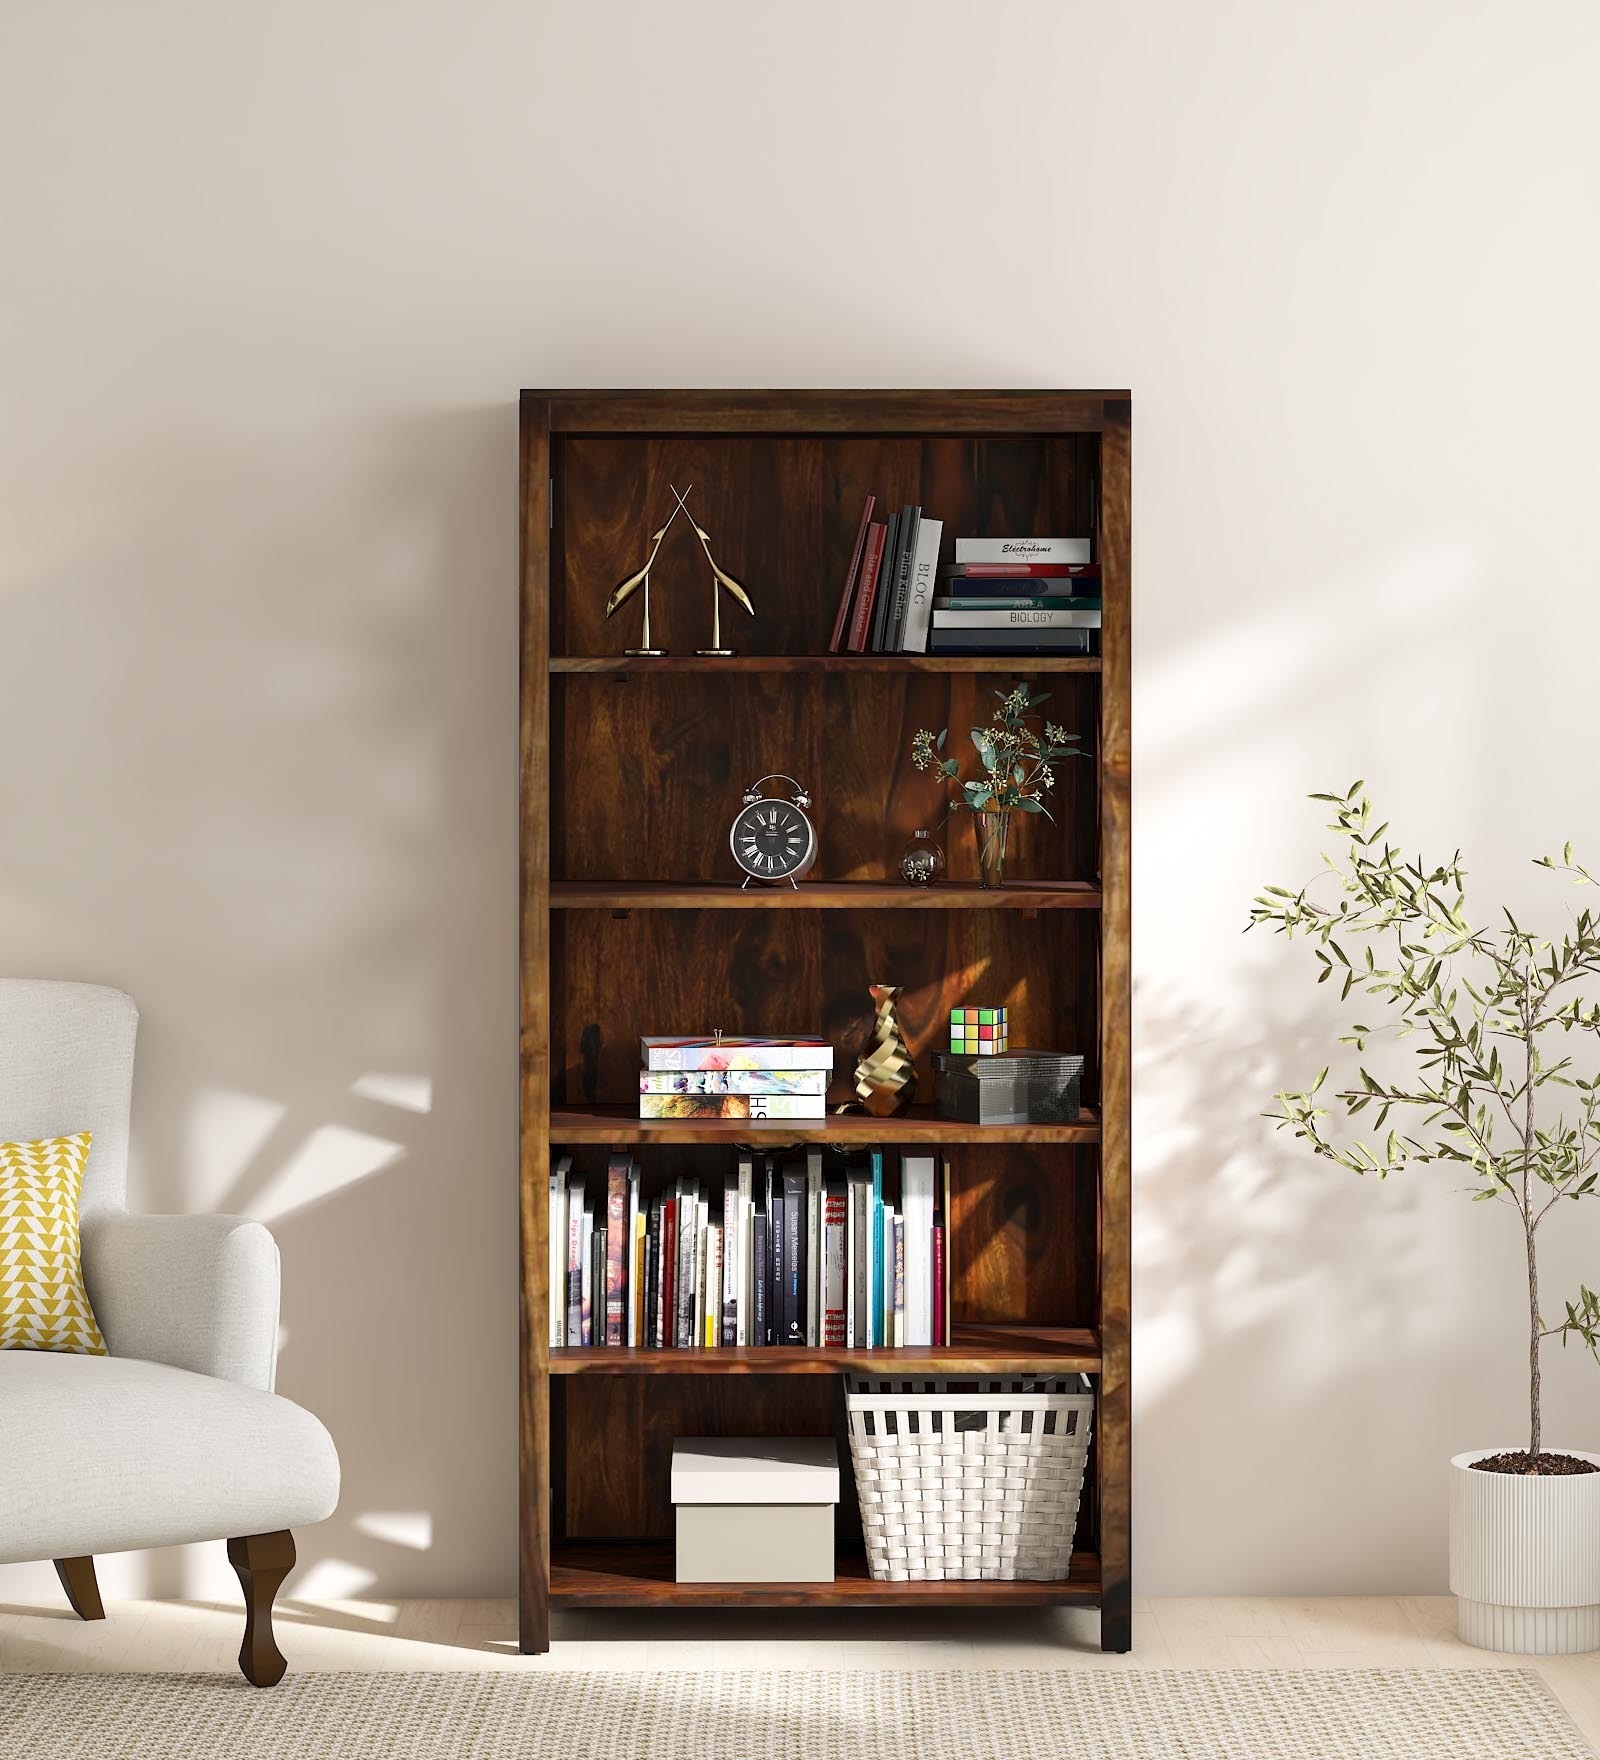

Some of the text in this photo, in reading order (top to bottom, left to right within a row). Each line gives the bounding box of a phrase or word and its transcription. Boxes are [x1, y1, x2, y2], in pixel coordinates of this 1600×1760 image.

[1001, 543, 1052, 554] Electrohome
[893, 551, 913, 621] Film Kitchen
[913, 562, 931, 606] BLOG
[1010, 612, 1054, 623] BIOLOGY
[570, 1219, 579, 1237] Pipe
[790, 1211, 799, 1235] Susan
